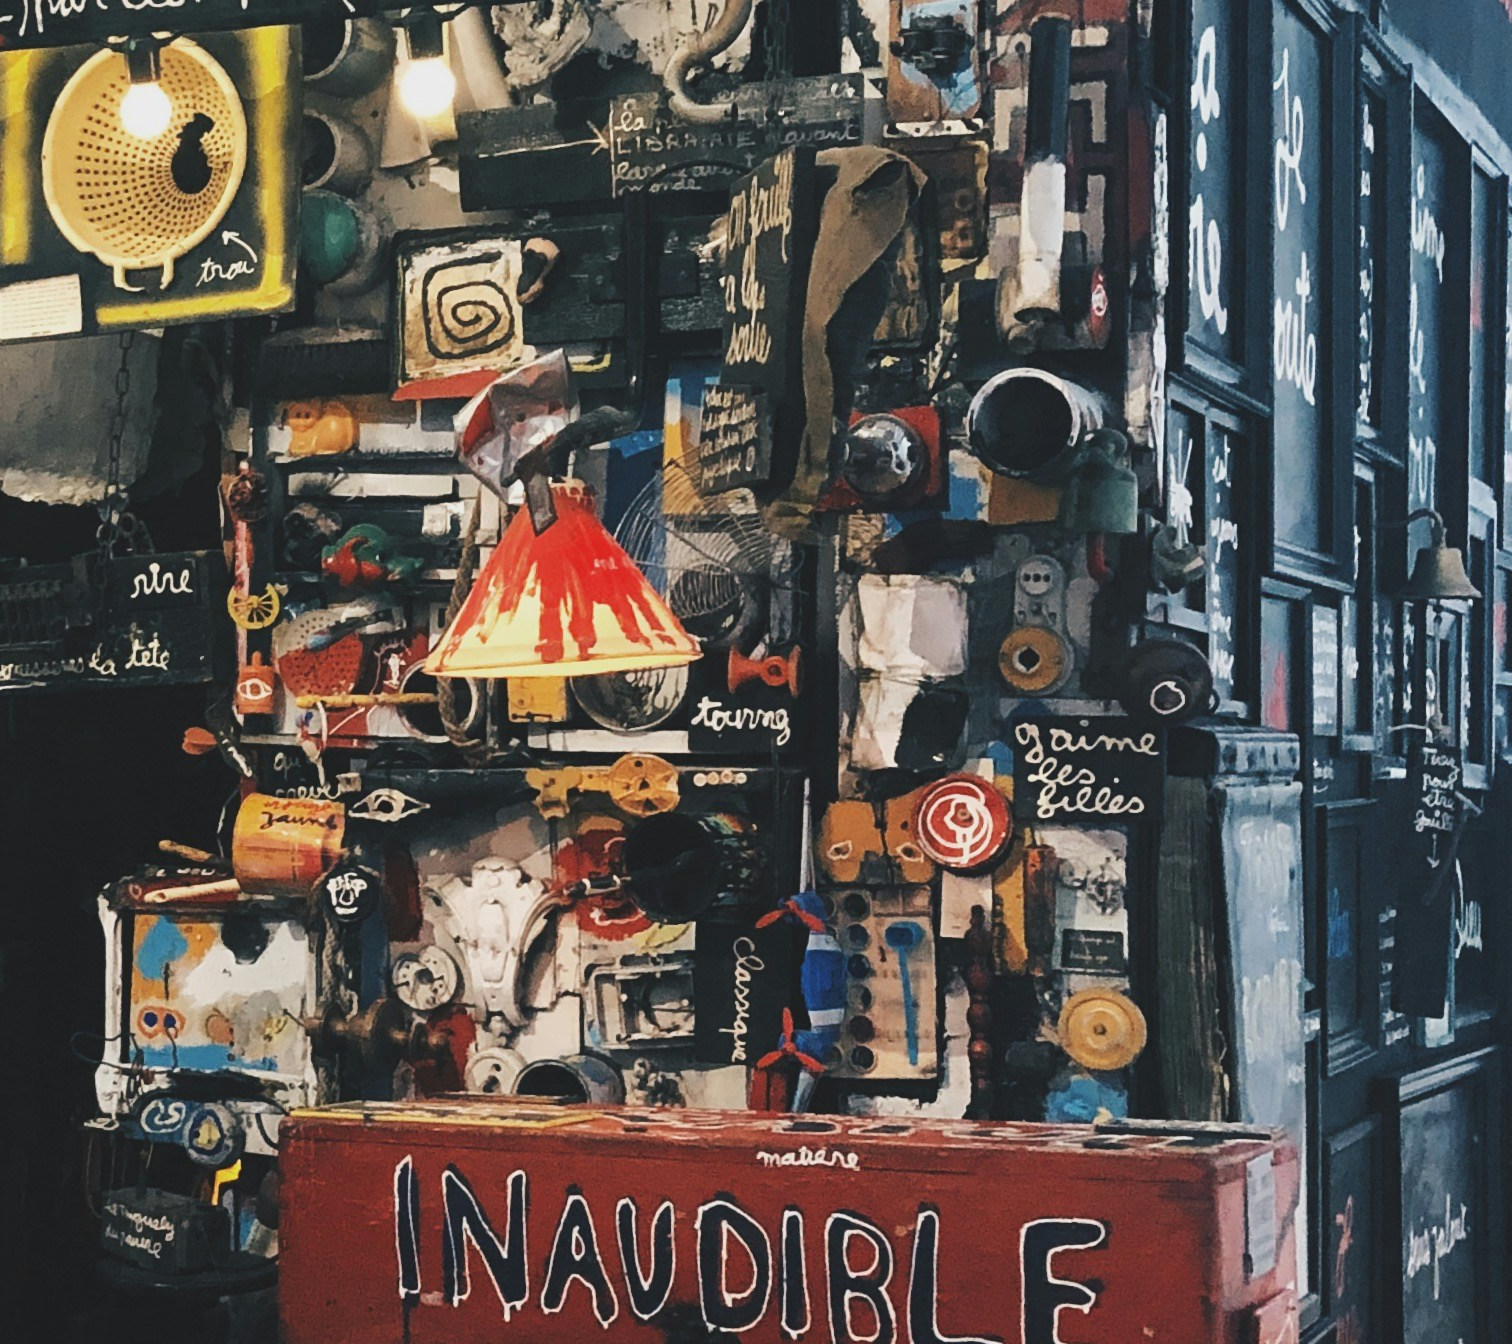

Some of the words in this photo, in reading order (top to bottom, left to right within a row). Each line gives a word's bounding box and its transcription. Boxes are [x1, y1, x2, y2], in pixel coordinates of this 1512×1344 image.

[194, 255, 258, 288] trou
[130, 562, 194, 599] rire
[1026, 756, 1096, 787] les
